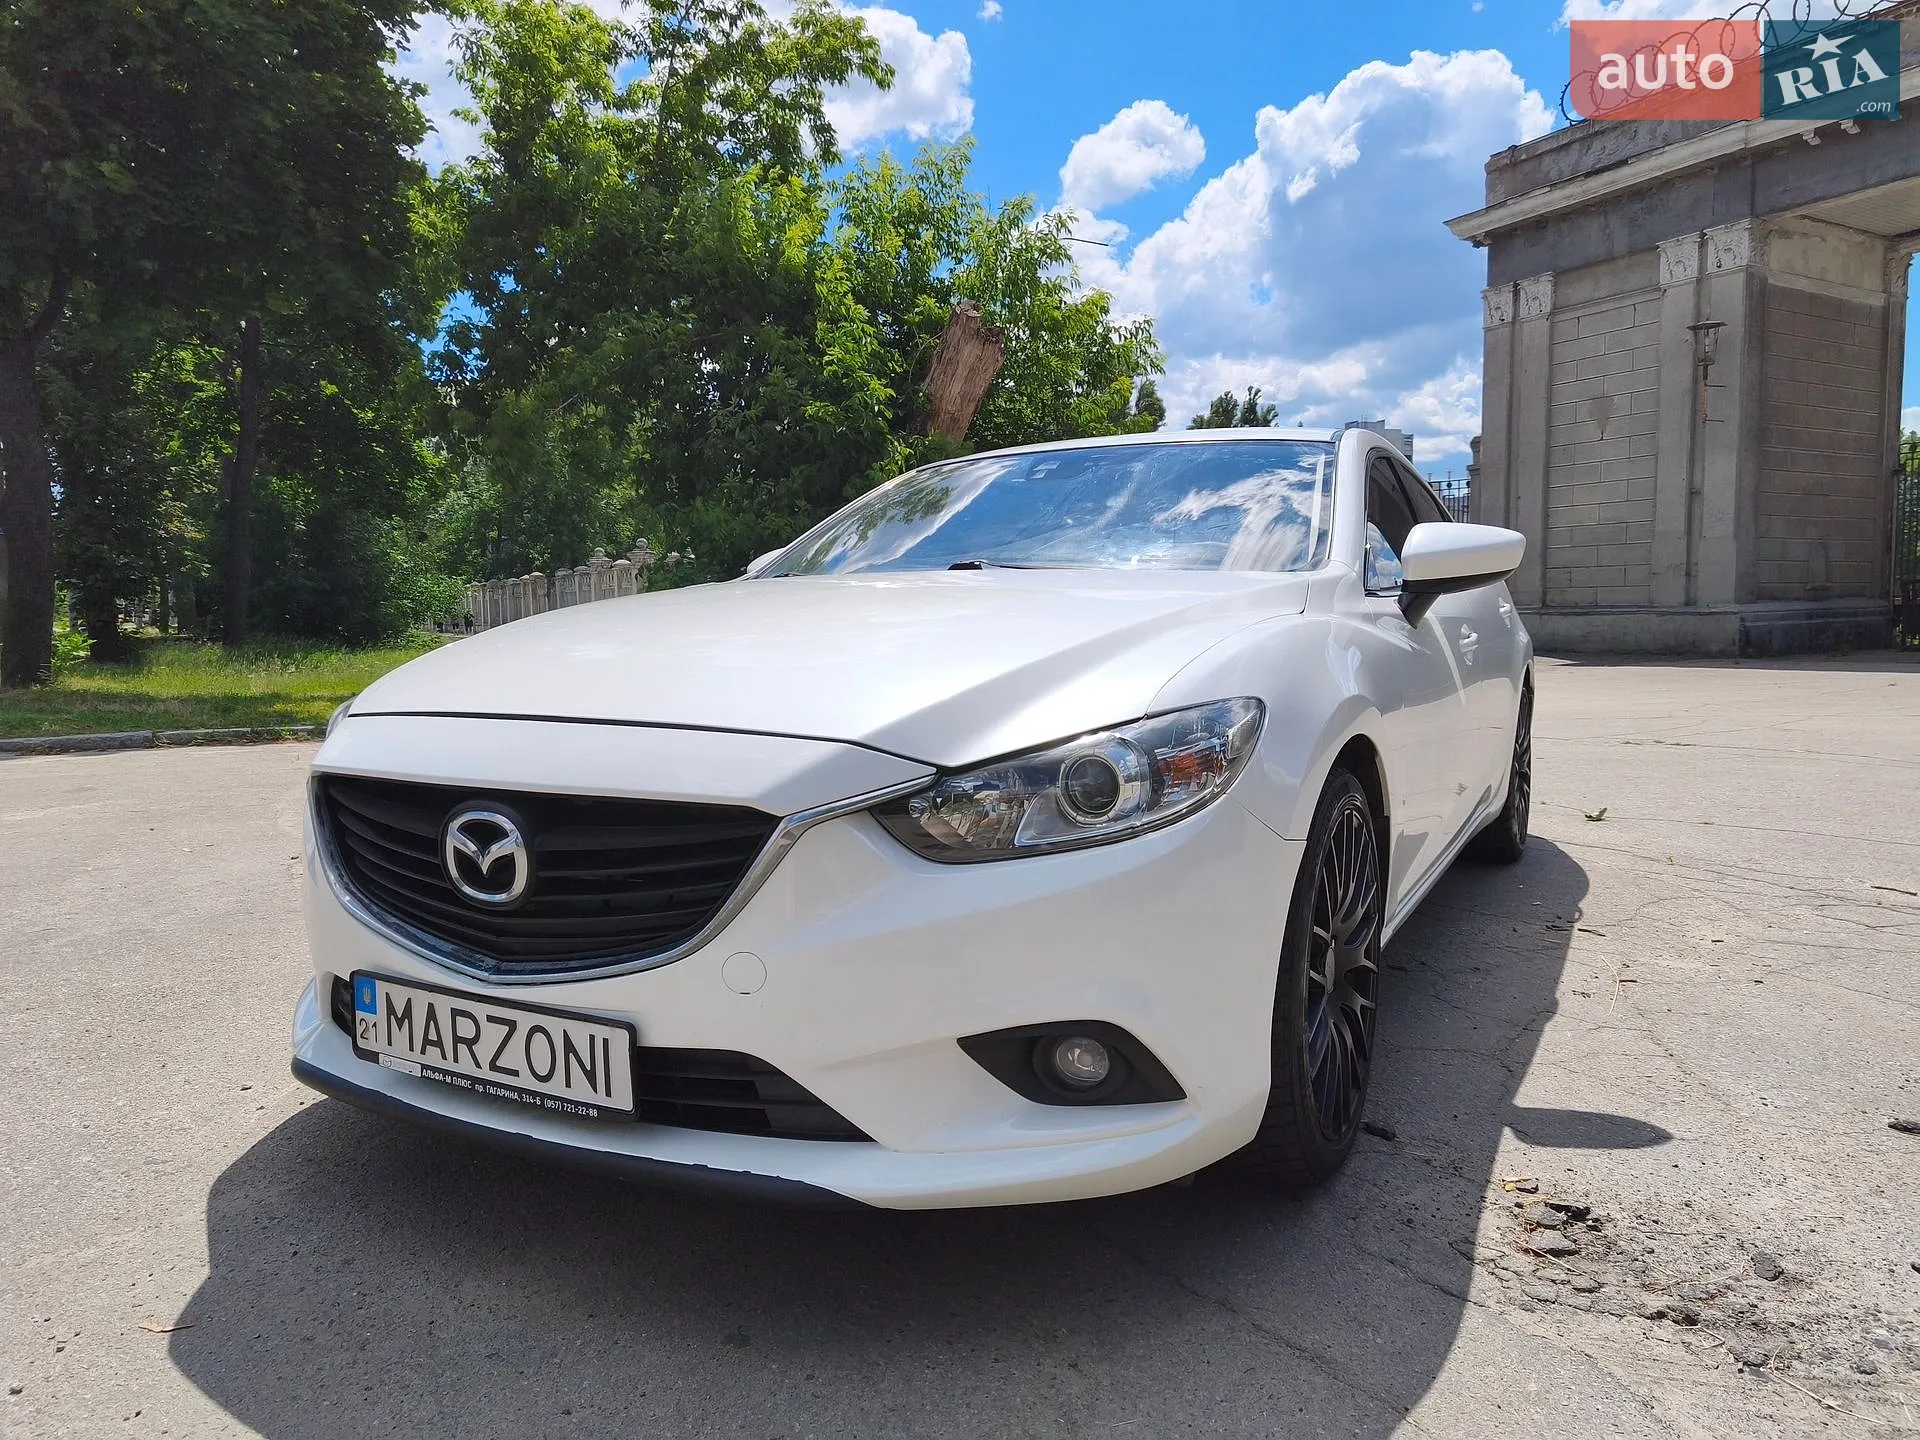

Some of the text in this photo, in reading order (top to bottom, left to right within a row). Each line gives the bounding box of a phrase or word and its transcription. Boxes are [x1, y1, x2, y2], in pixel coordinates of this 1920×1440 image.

[359, 1017, 378, 1044] 21
[385, 991, 612, 1098] MARZONI
[422, 1068, 452, 1083] АЛЬФА-М
[452, 1076, 472, 1089] ПЛЮС
[486, 1085, 521, 1102] ГАГАРИНА,
[544, 1098, 562, 1112] (057)
[563, 1102, 598, 1118] 721-22-88
